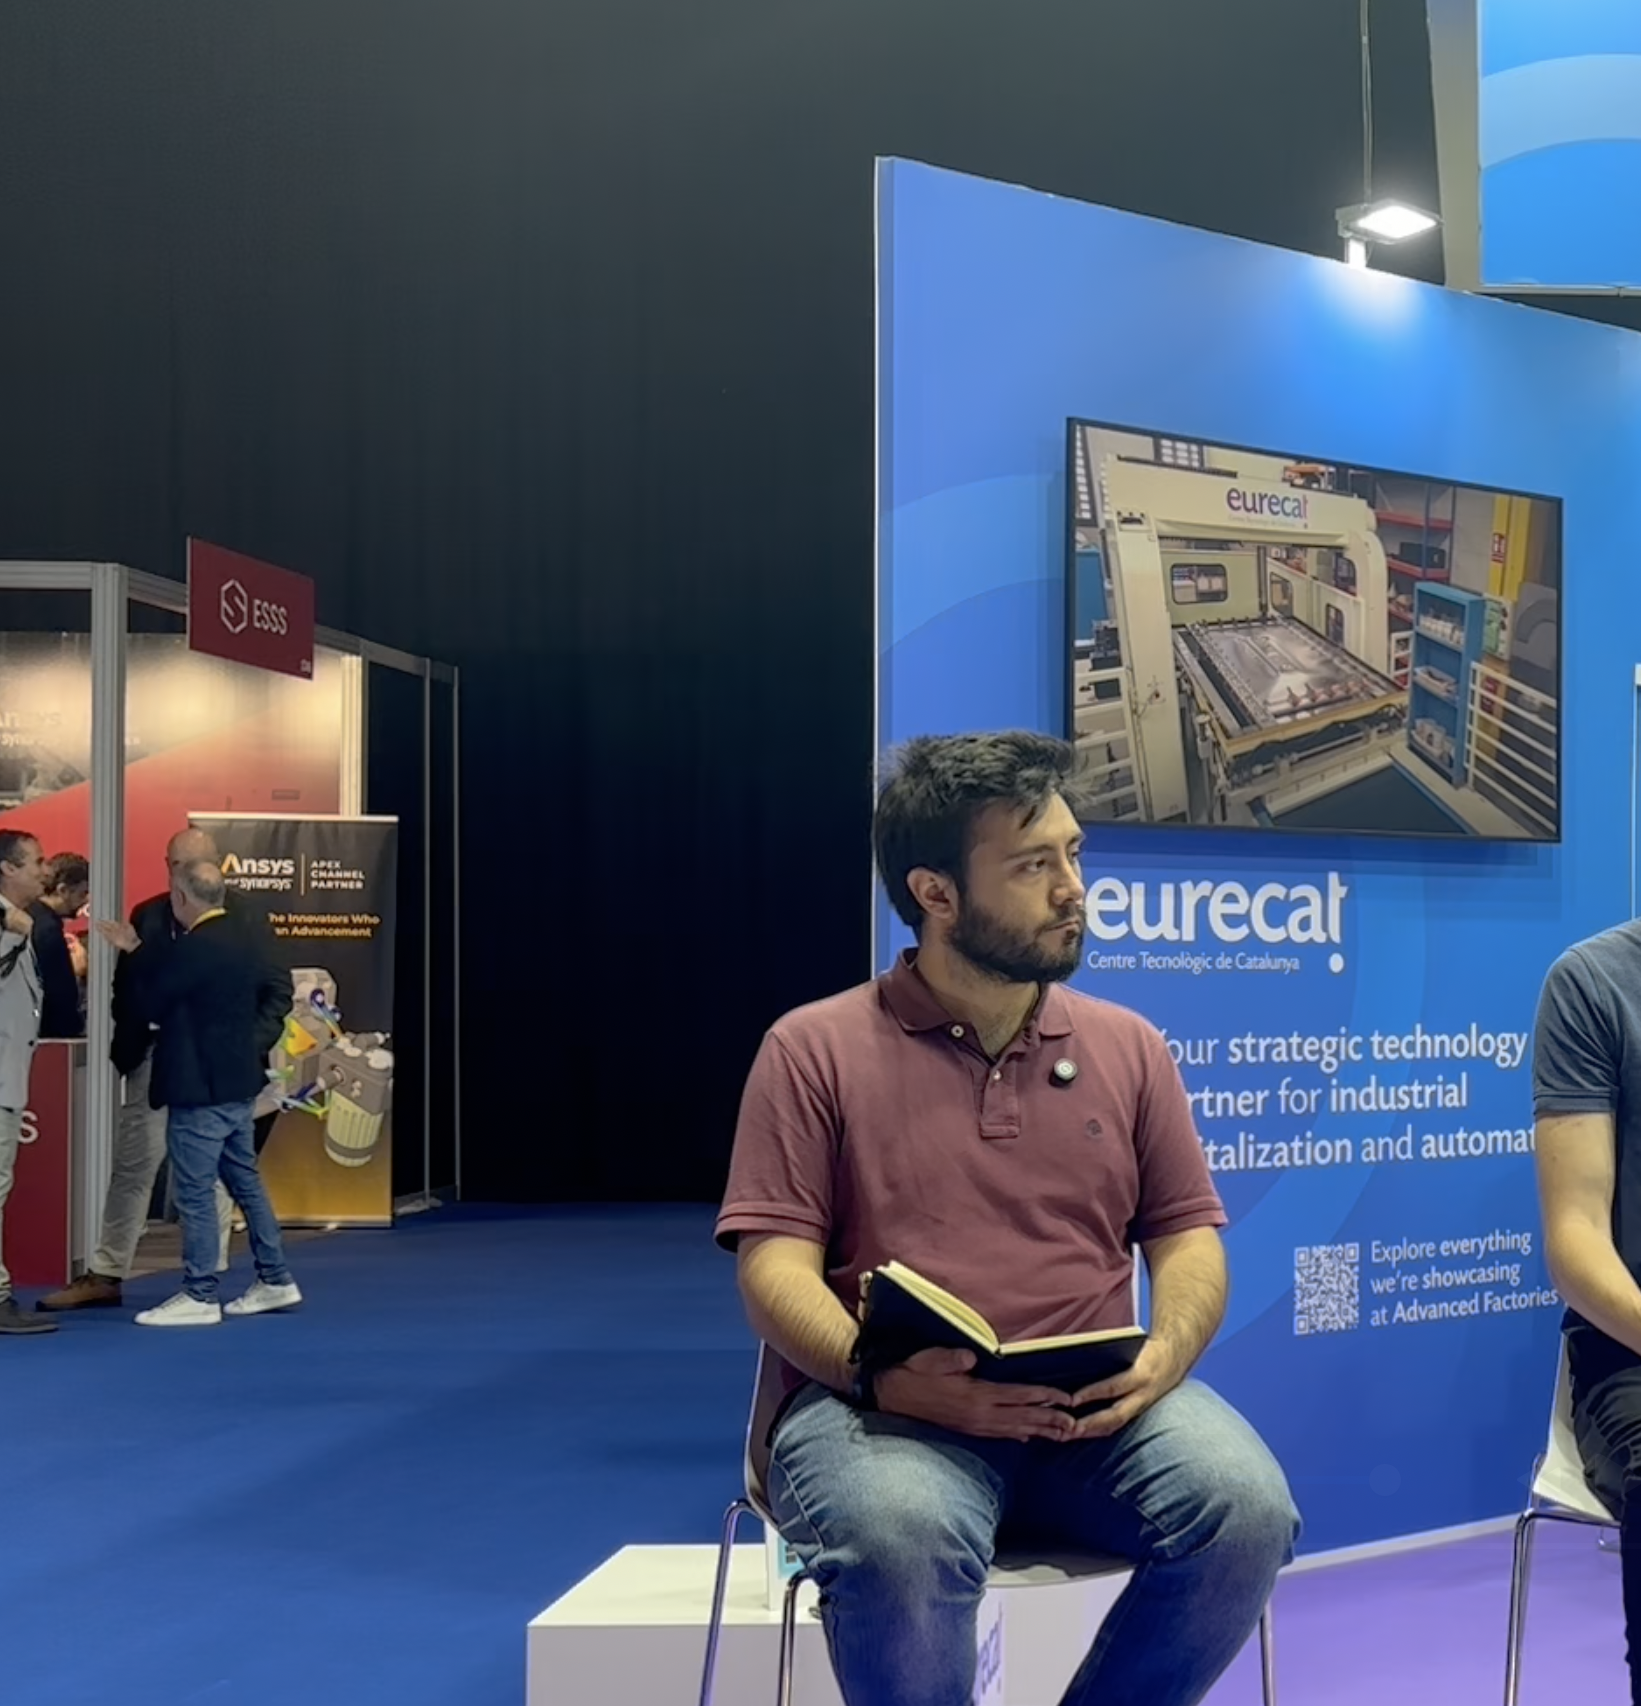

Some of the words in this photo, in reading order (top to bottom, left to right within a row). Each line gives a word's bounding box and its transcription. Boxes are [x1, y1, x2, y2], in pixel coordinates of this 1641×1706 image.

[1227, 488, 1308, 519] eurecat
[254, 599, 288, 635] ESSS
[221, 853, 295, 876] Ansys
[310, 860, 341, 869] APEX
[310, 870, 365, 879] CHANNEL
[311, 880, 363, 890] PARTNER
[288, 913, 349, 924] Innovators
[350, 914, 380, 924] Who
[1085, 872, 1348, 944] eurecat
[291, 926, 372, 938] Advancement
[1087, 951, 1136, 970] Centre
[1139, 951, 1211, 974] Tecnològic
[1215, 953, 1233, 969] de
[1236, 953, 1300, 975] Catalunya
[1161, 1028, 1219, 1065] our
[1228, 1026, 1363, 1074] strategic
[1370, 1022, 1528, 1068] technology
[1186, 1085, 1270, 1119] rtner
[1278, 1076, 1322, 1114] for
[1331, 1071, 1467, 1113] industrial
[1201, 1130, 1353, 1171] talization
[1361, 1123, 1413, 1163] and
[1421, 1123, 1536, 1160] automat
[1370, 1237, 1436, 1269] Explore
[1440, 1228, 1532, 1260] everything
[1422, 1261, 1521, 1286] showcasing
[1370, 1306, 1388, 1326] at
[1392, 1292, 1479, 1324] Advanced
[1483, 1286, 1559, 1312] Factories
